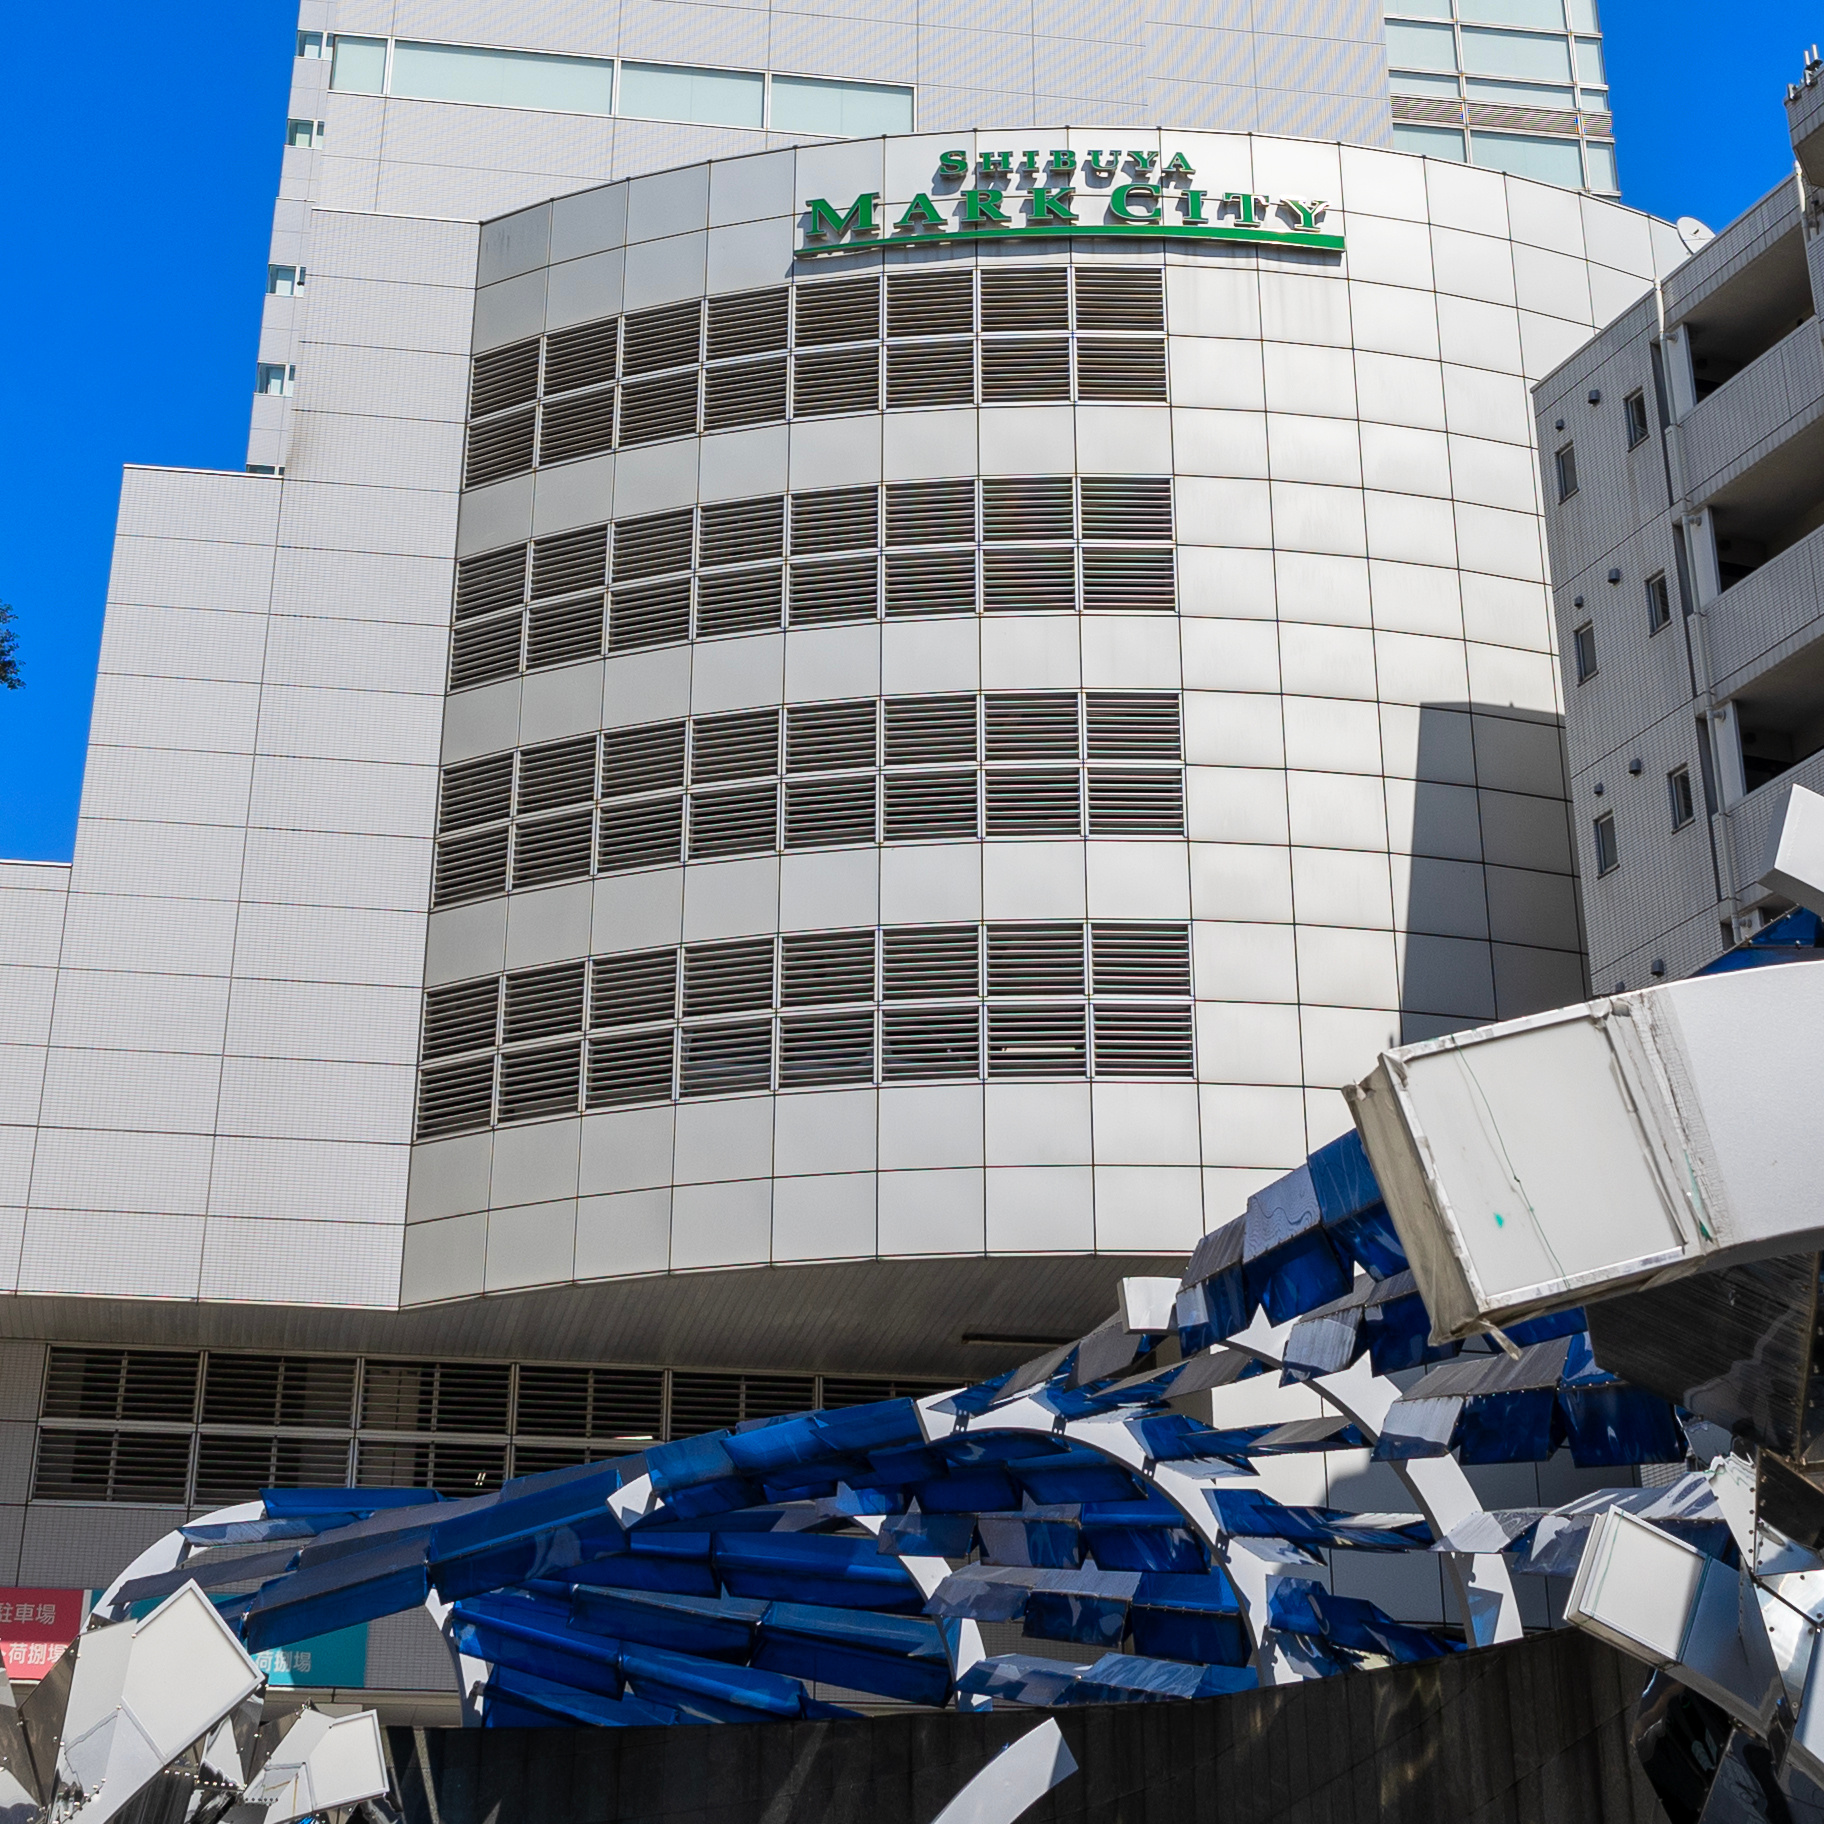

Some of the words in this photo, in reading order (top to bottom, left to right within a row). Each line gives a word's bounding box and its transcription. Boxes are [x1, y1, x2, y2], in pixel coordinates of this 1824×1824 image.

[939, 150, 1196, 176] SHIBUYA
[805, 186, 1080, 237] MARK
[1110, 183, 1330, 232] CITY
[255, 1650, 312, 1672] 荷捌場
